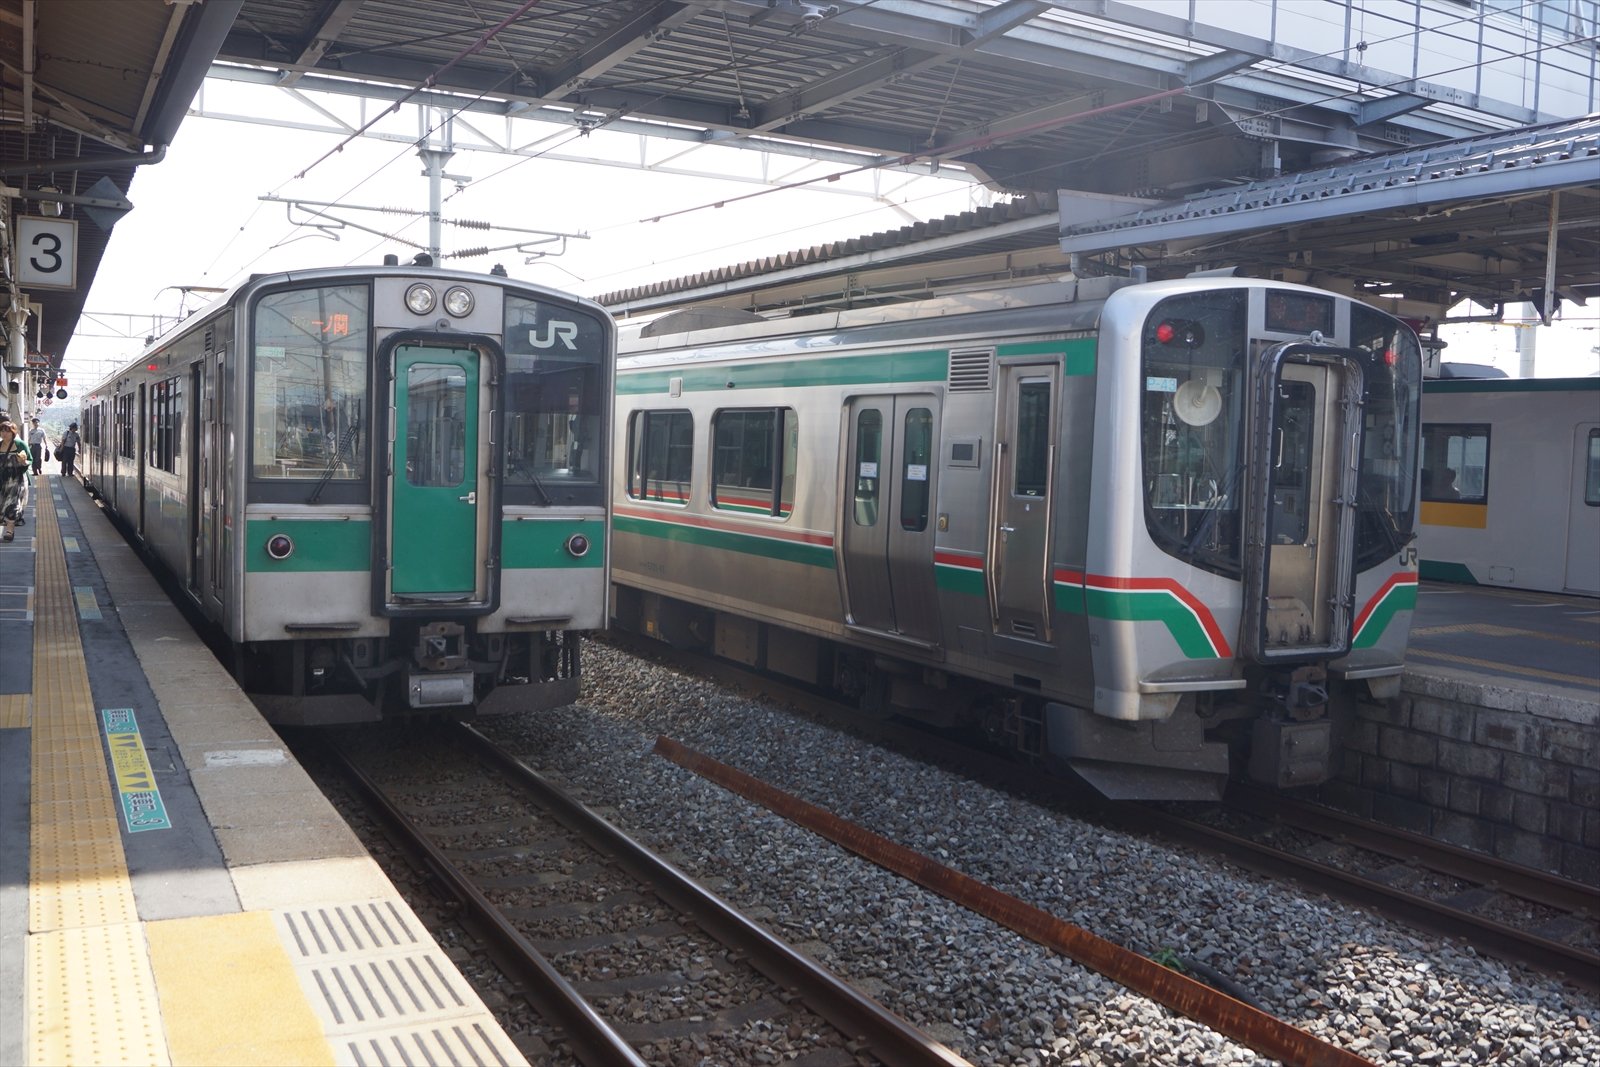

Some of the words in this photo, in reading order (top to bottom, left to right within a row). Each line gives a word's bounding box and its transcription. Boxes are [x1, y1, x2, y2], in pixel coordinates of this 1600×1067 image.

[30, 232, 62, 273] 3
[529, 320, 578, 350] JR
[1399, 547, 1417, 566] JR
